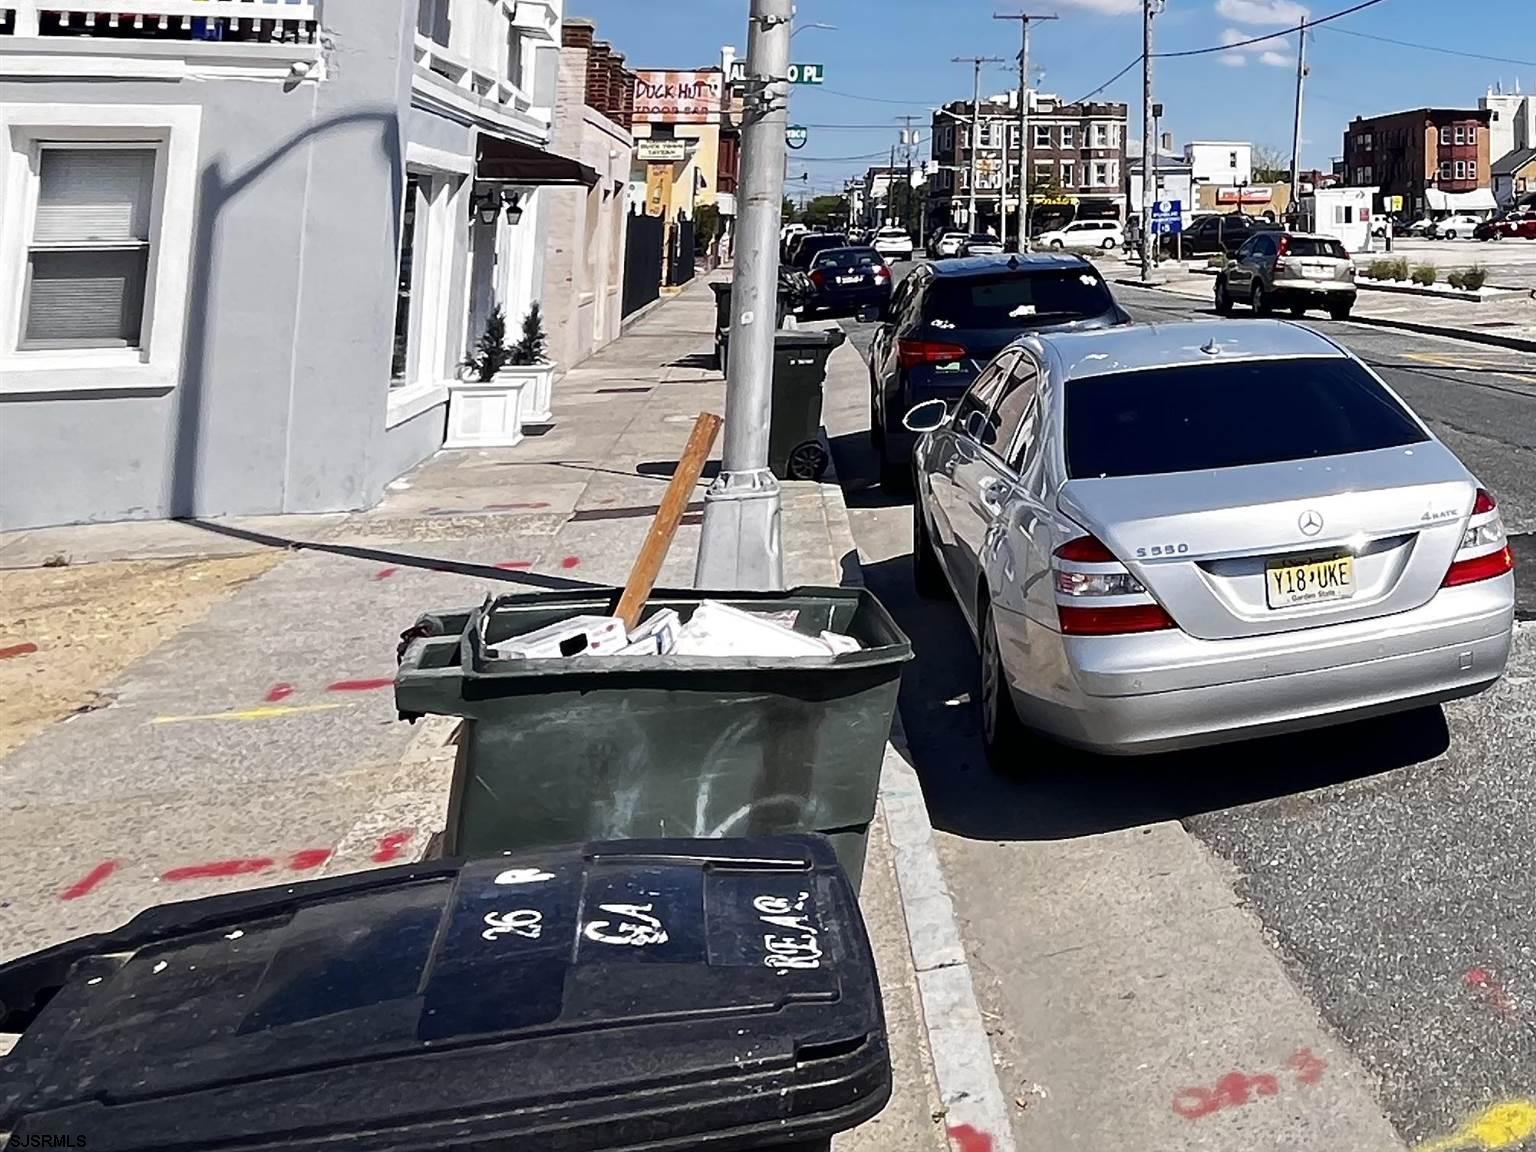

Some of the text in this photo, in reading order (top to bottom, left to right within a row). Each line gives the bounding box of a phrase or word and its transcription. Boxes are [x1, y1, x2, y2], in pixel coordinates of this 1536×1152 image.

[804, 65, 823, 82] PL
[635, 80, 707, 99] DUCK HUT
[1291, 593, 1316, 602] Garden
